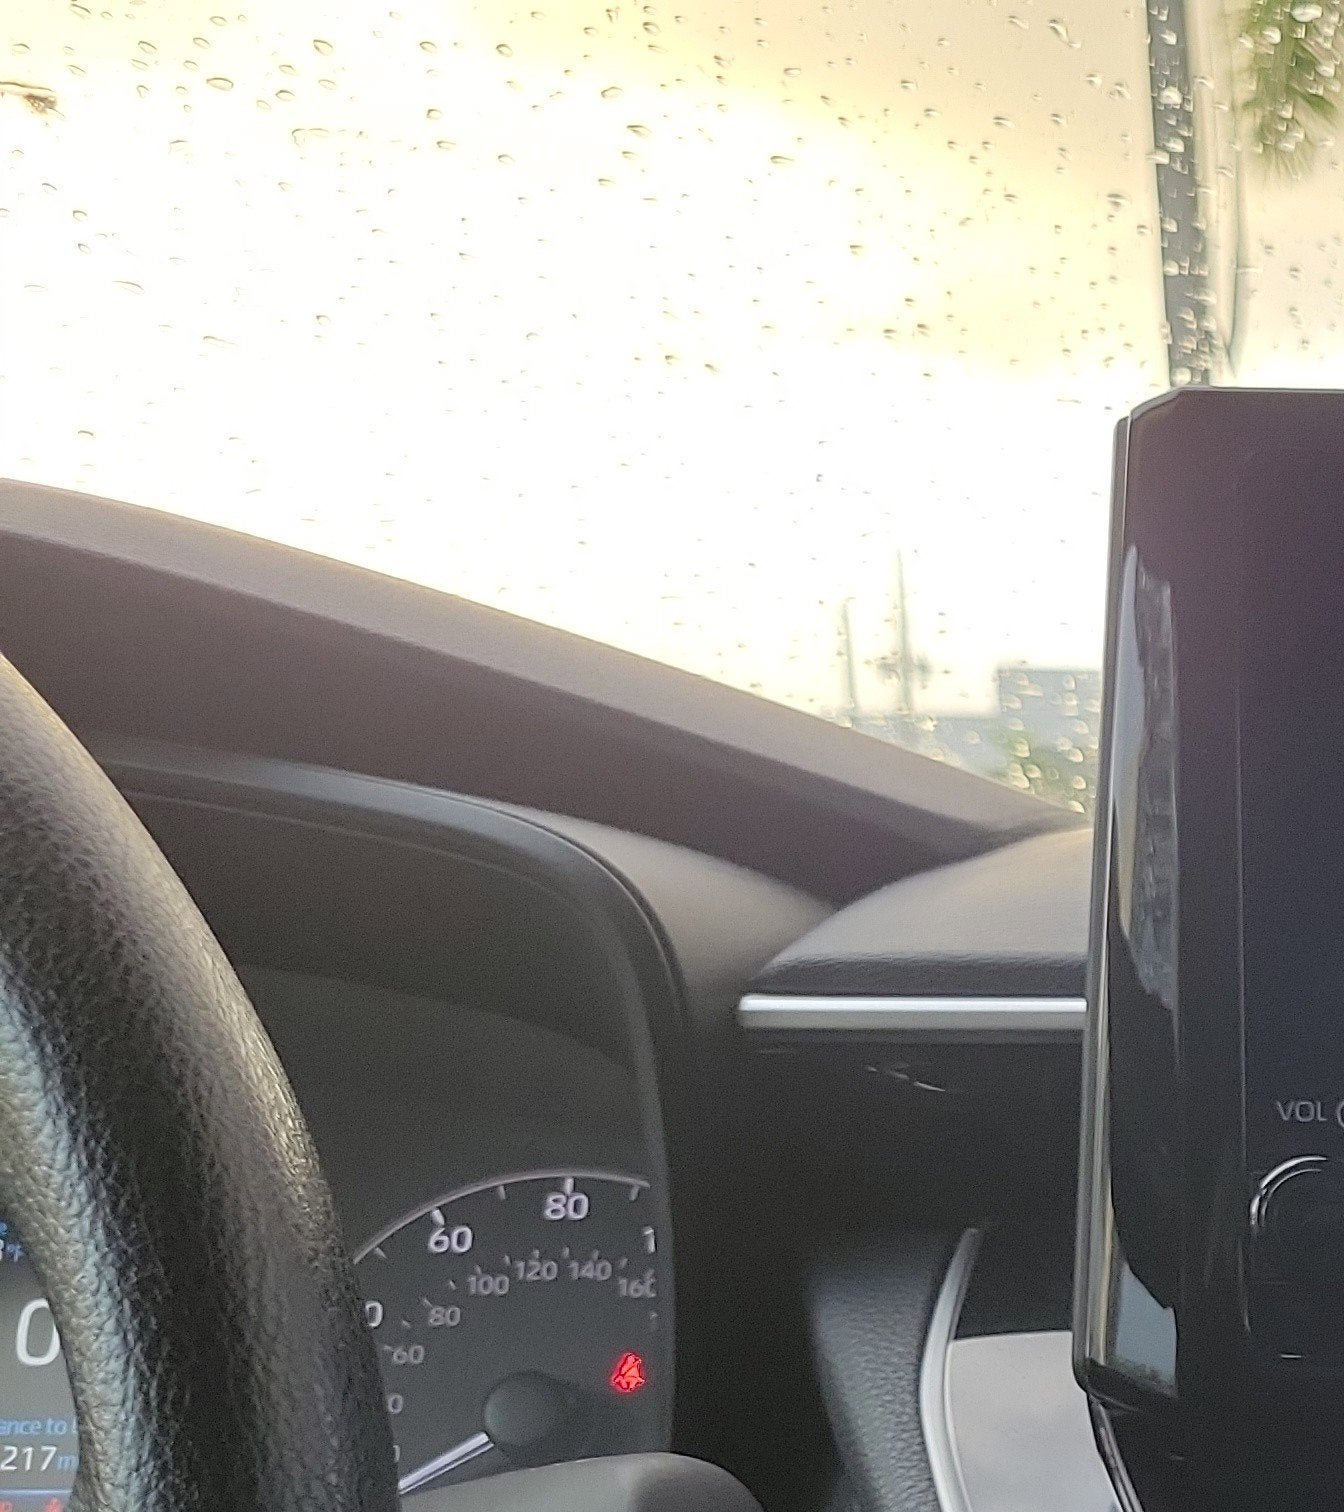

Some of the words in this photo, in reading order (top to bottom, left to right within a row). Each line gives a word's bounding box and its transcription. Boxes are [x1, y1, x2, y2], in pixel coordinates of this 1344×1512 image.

[1276, 1100, 1328, 1122] VOL
[544, 1192, 589, 1221] 80
[428, 1225, 473, 1254] 60
[514, 1260, 558, 1282] 120
[569, 1259, 613, 1281] 140
[468, 1274, 510, 1297] 100
[428, 1306, 462, 1328] 80
[392, 1344, 425, 1366] 60
